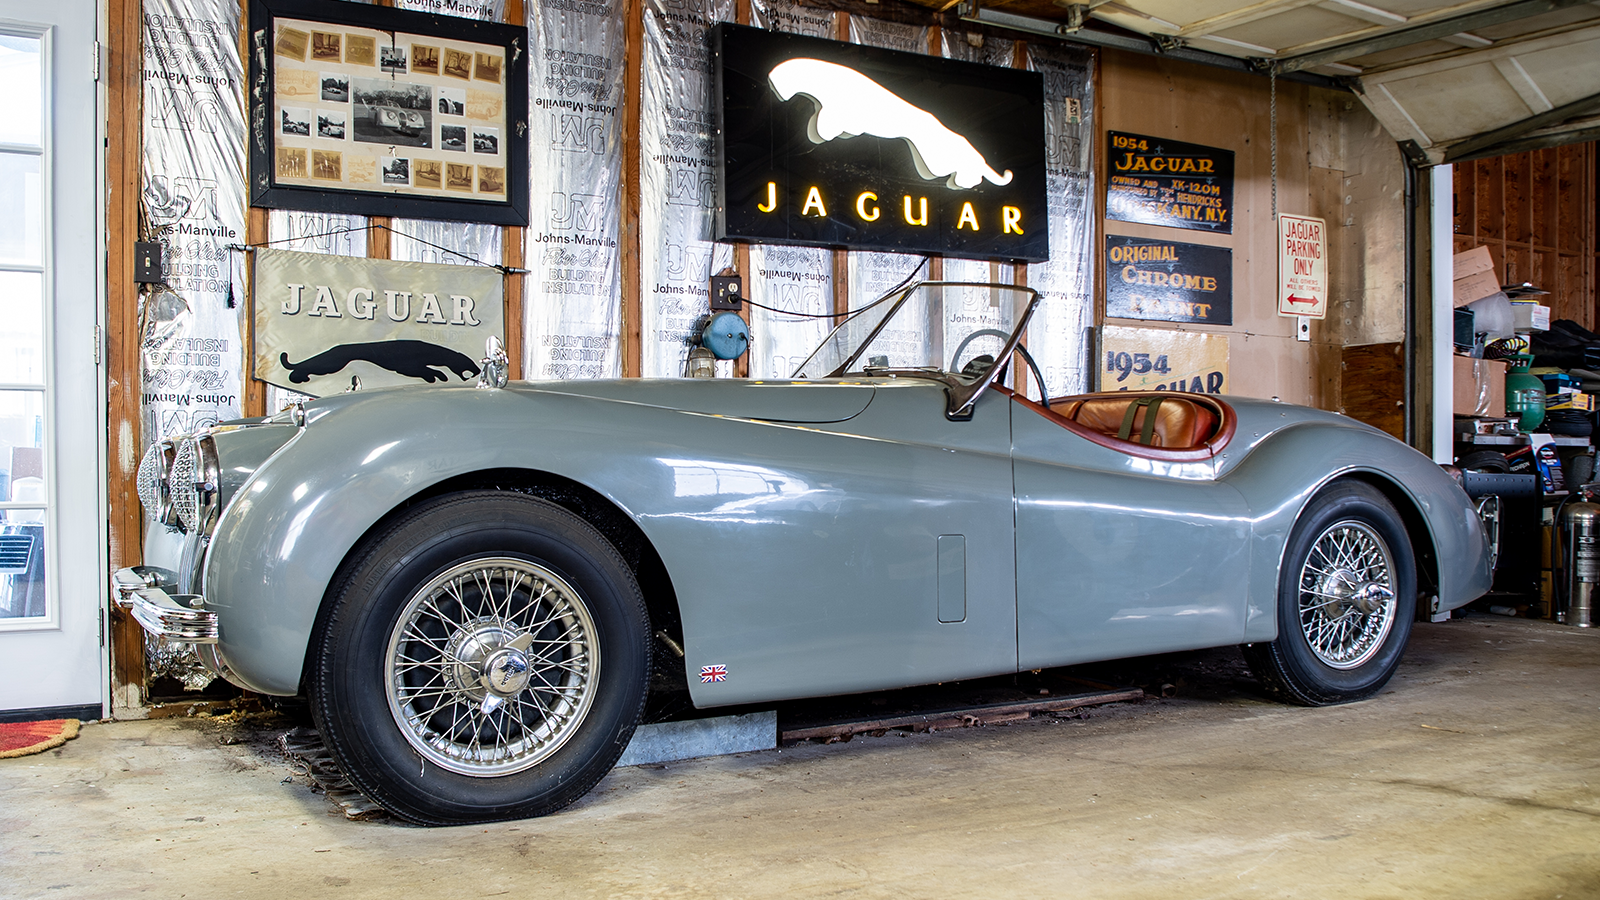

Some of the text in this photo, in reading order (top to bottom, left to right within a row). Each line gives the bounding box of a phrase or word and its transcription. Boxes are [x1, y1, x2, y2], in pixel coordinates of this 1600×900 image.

[536, 97, 617, 117] Johns-Manville
[551, 113, 605, 156] JM
[1113, 136, 1149, 152] 1954
[1115, 152, 1215, 174] JAGUAR
[1111, 175, 1159, 189] OWNED AND
[1171, 179, 1221, 198] XK-120M
[757, 181, 1024, 236] JAGUAR
[1176, 192, 1222, 209] HENDRICKS
[551, 191, 604, 233] JM
[1206, 207, 1228, 223] N.Y.
[535, 232, 616, 249] Johns-Manville
[1285, 221, 1320, 241] JAGUAR
[1110, 246, 1179, 264] ORIGINAL
[1286, 239, 1320, 259] PARKING
[161, 263, 219, 279] UILDING
[668, 244, 713, 284] JM
[1293, 258, 1314, 276] ONLY
[549, 268, 605, 283] BUILDING
[760, 269, 830, 285] Johns-Manville
[1121, 264, 1218, 292] CHROME
[281, 283, 481, 327] JAGUAR
[1127, 294, 1212, 318] PAINT
[151, 352, 221, 367] BUILDING
[1107, 350, 1171, 383] 1954
[185, 369, 229, 391] Fiber
